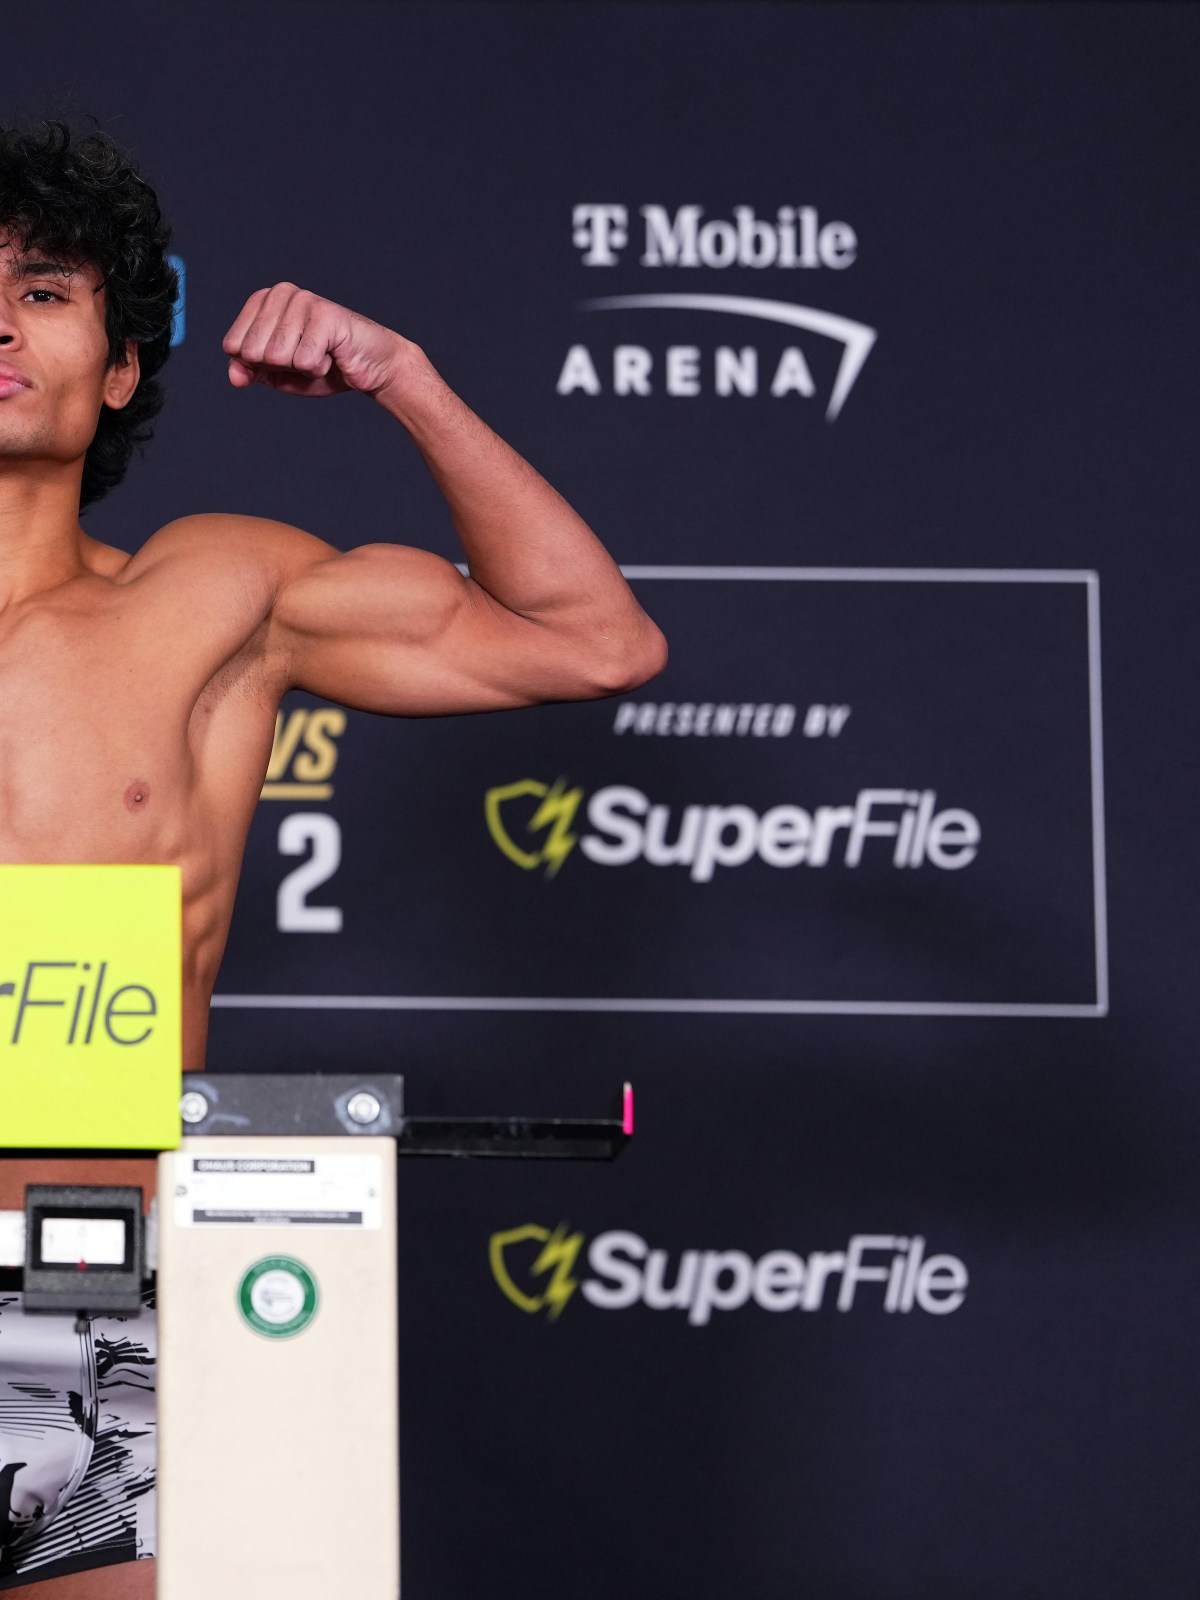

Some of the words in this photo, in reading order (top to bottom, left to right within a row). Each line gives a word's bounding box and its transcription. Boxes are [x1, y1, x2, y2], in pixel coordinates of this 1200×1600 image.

[642, 205, 857, 269] Mobile
[557, 345, 815, 397] ARENA
[266, 709, 347, 781] VS
[613, 703, 796, 738] PRESENTED
[803, 704, 850, 738] BY
[580, 786, 981, 882] SuperFile
[277, 812, 343, 933] 2
[581, 1231, 968, 1326] SuperFile
